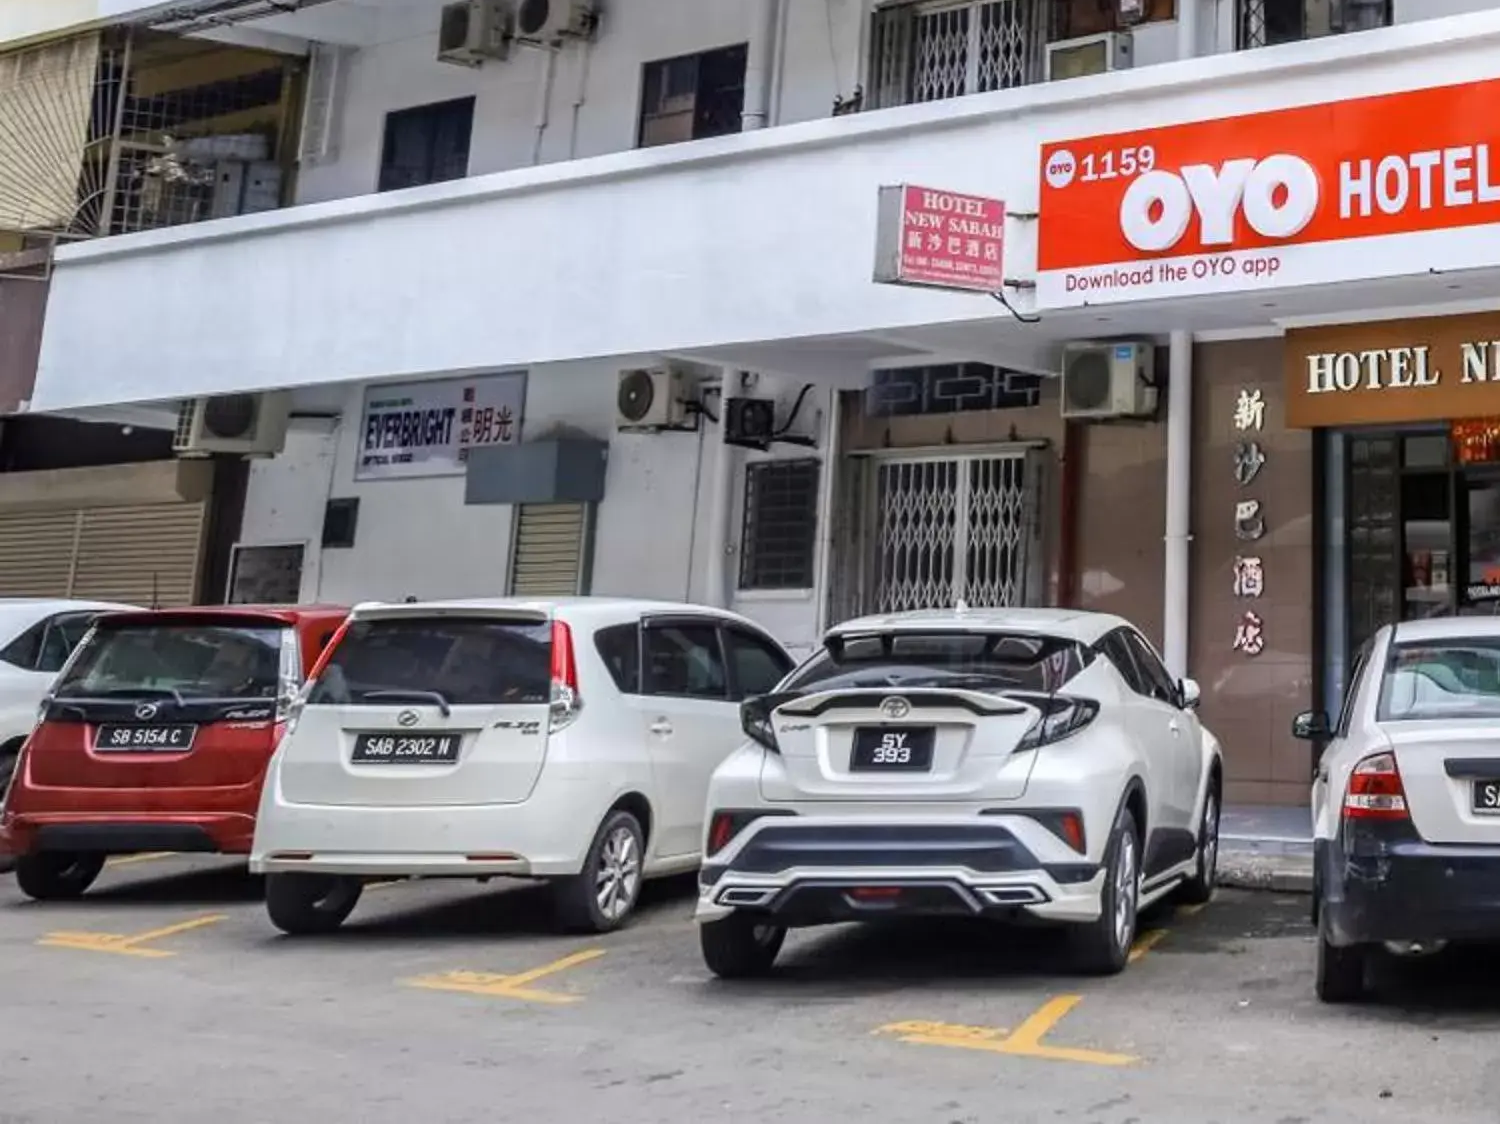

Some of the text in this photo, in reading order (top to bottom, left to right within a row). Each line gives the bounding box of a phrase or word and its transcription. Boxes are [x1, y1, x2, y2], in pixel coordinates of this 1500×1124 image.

[1049, 162, 1073, 175] OYO
[1080, 145, 1156, 182] 1159
[922, 191, 987, 218] HOTEL
[1119, 152, 1319, 252] OYO
[905, 210, 1003, 240] NEW SABAH
[1065, 256, 1281, 293] Download the OYO app
[1306, 345, 1441, 394] HOTEL
[365, 406, 456, 450] EVERBRIGHT
[473, 404, 513, 443] 明光
[110, 729, 181, 744] SB 5154 C
[365, 737, 450, 756] SAB 2302 N
[882, 733, 908, 749] SY
[871, 747, 911, 763] 393
